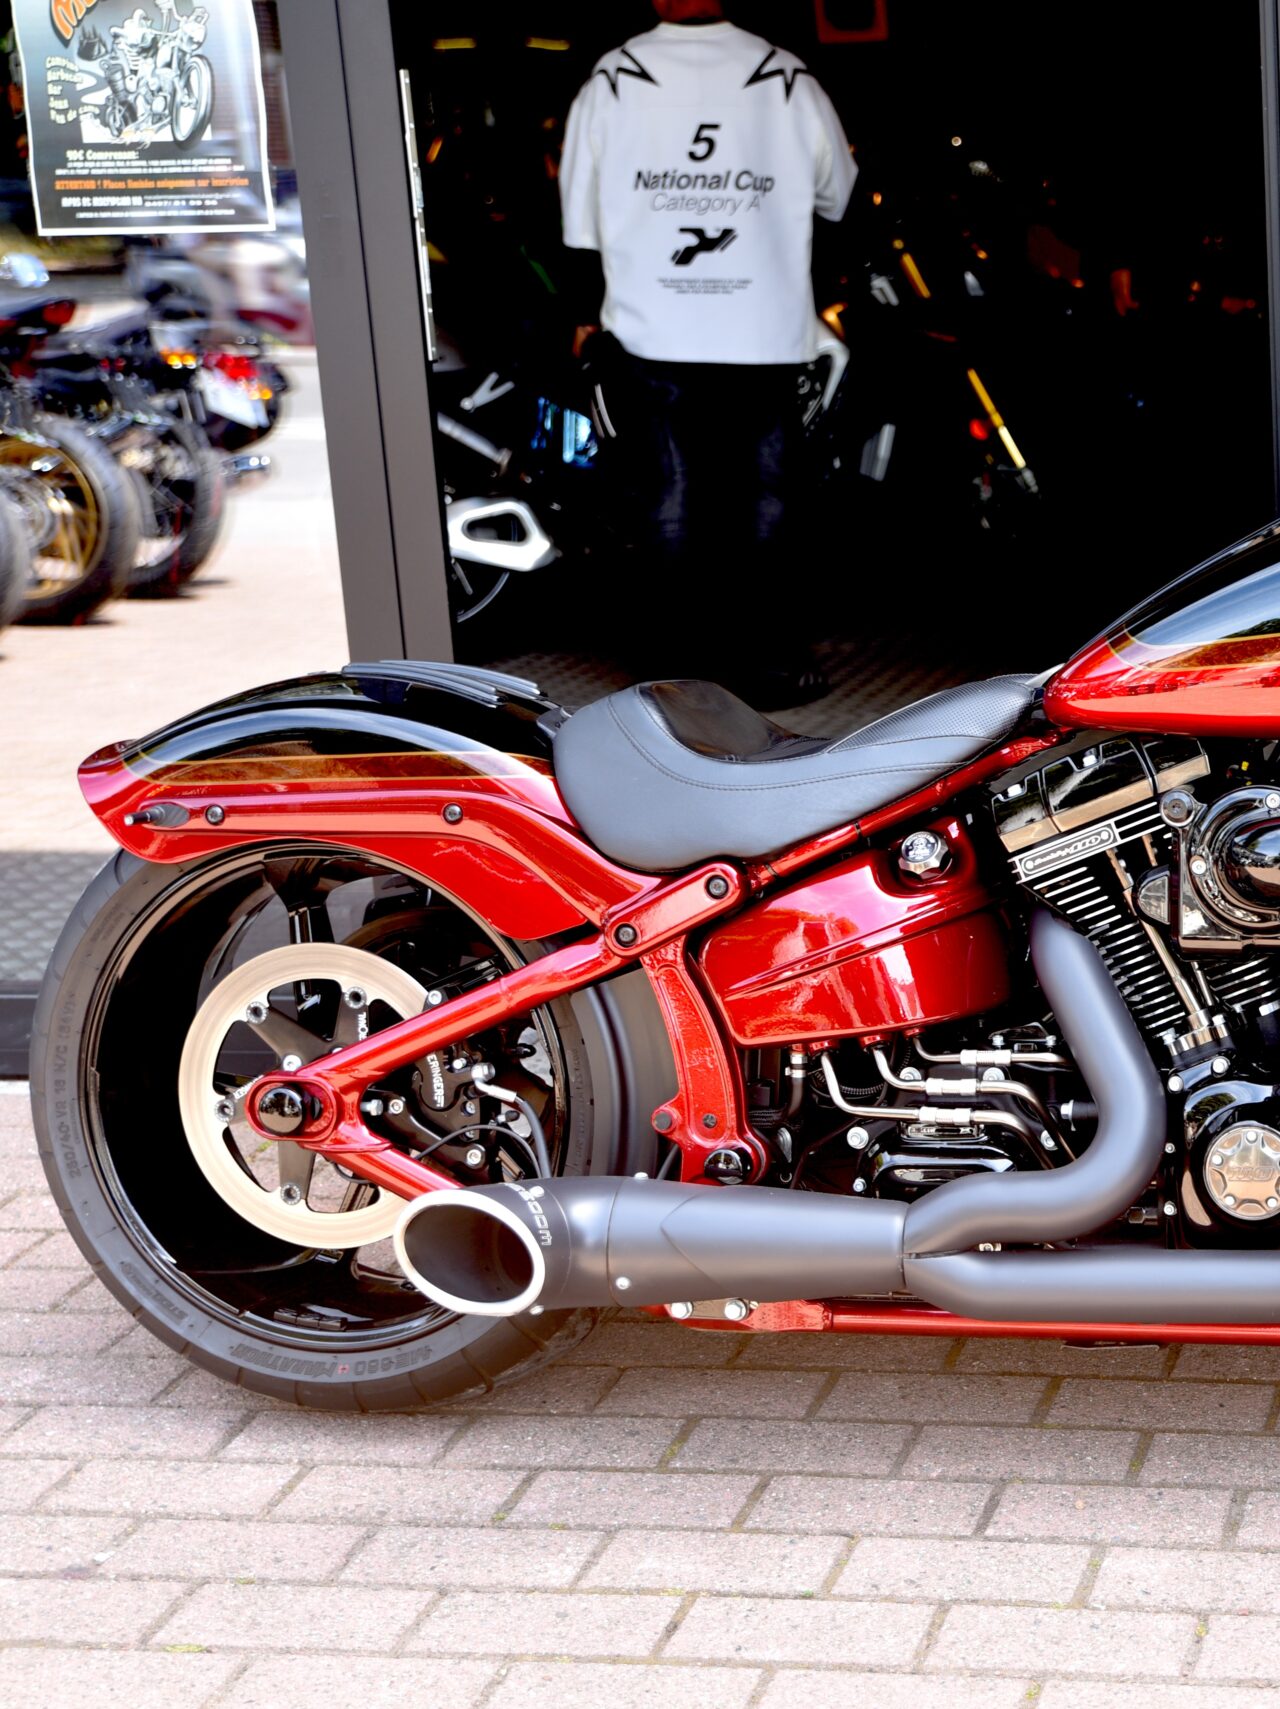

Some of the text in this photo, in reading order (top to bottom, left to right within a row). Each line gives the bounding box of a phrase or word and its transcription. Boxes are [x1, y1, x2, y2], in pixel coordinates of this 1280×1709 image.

[688, 124, 721, 161] 5
[633, 171, 775, 196] National Cup
[650, 193, 761, 216] Category A
[427, 1053, 445, 1108] ERINGER
